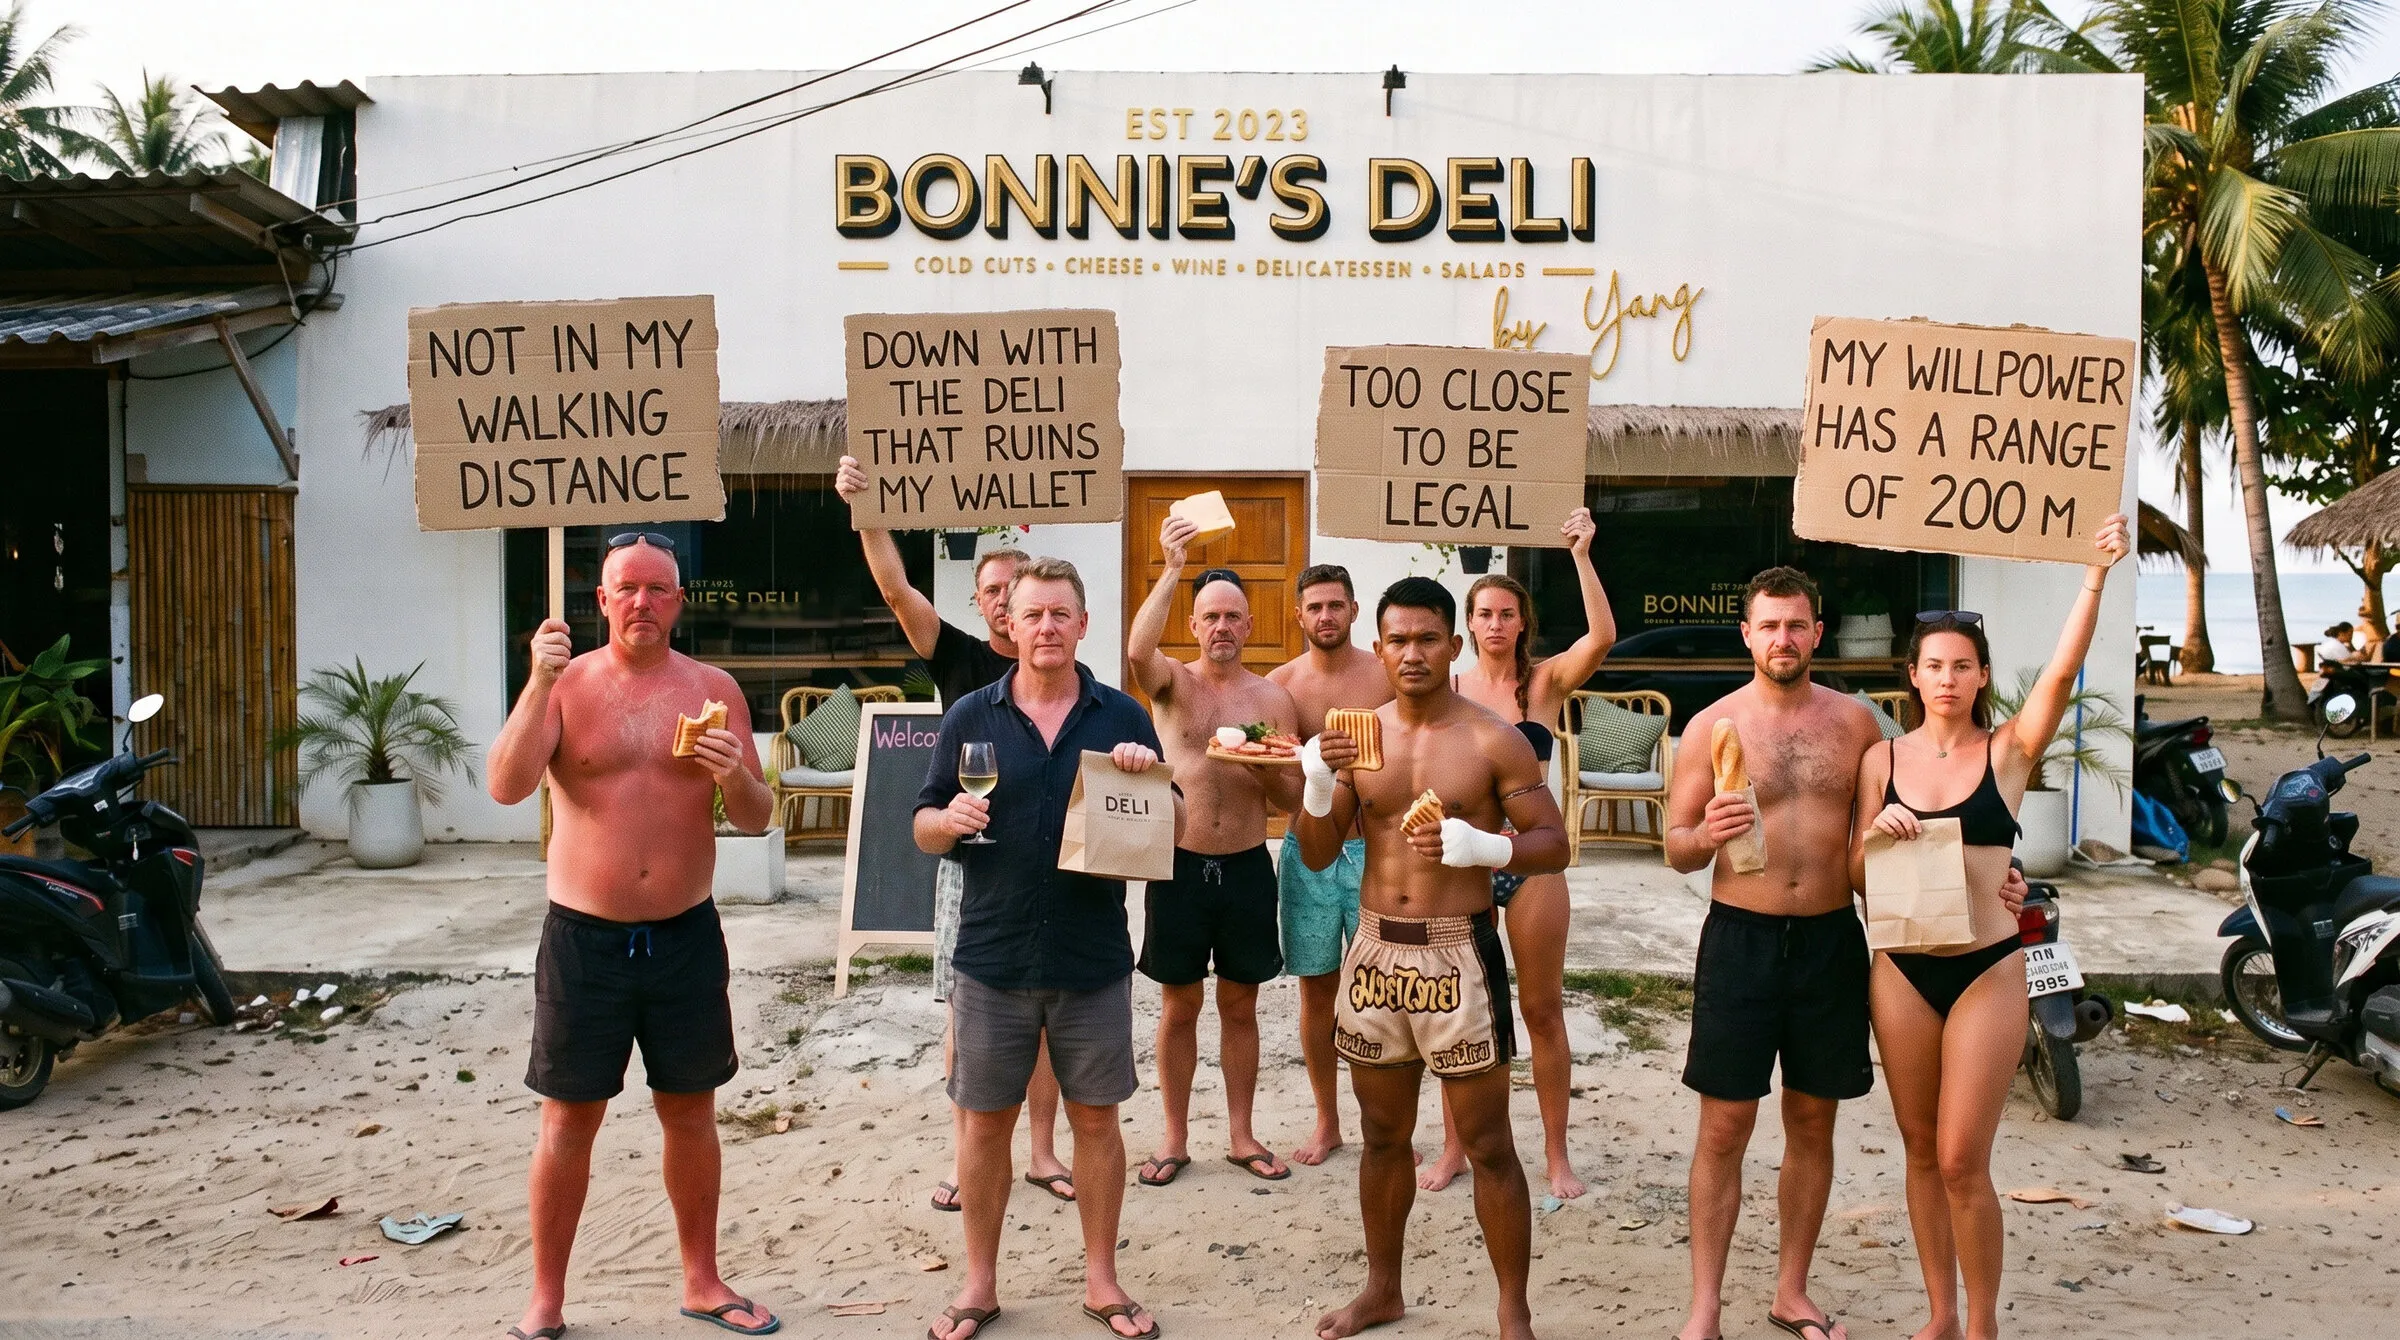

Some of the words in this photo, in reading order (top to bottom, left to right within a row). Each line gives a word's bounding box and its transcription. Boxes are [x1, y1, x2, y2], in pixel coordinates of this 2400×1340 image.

[1126, 108, 1193, 140] EST
[1213, 108, 1309, 142] 2023
[835, 153, 1331, 243] BONNIE'S
[1368, 157, 1596, 244] DELI
[914, 256, 973, 274] COLD
[984, 257, 1036, 274] CUTS
[1065, 257, 1143, 275] CHEESE
[1171, 259, 1227, 276] WINE
[1255, 259, 1412, 278] DELICATESSEN
[1441, 261, 1526, 279] SALADS
[1584, 269, 1705, 380] Yang
[429, 325, 526, 378] NOT
[553, 323, 599, 373] IN
[626, 318, 694, 370] MY
[862, 329, 980, 370] DOWN
[1000, 326, 1097, 366] WITH
[1339, 364, 1422, 409] TOO
[1442, 368, 1573, 413] CLOSE
[1821, 338, 1888, 388] MY
[1907, 344, 2126, 406] WILLPOWER
[457, 388, 669, 444] WALKING
[889, 378, 964, 417] THE
[984, 376, 1065, 415] DELI
[862, 426, 964, 466] THAT
[985, 422, 1100, 462] RUINS
[1392, 426, 1446, 467] TO
[1468, 428, 1520, 469] BE
[1815, 403, 1897, 453] HAS
[1917, 411, 1947, 458] A
[1970, 413, 2116, 471] RANGE
[459, 451, 690, 510] DISTANCE
[879, 474, 934, 514] MY
[951, 469, 1097, 511] WALLET
[1385, 480, 1530, 531] LEGAL
[1845, 473, 1904, 521] OF
[1924, 474, 2027, 534] 200
[689, 580, 708, 588] EST
[1644, 595, 1739, 614] BONNIE
[874, 720, 939, 749] Welco
[2027, 975, 2069, 994] 7995
